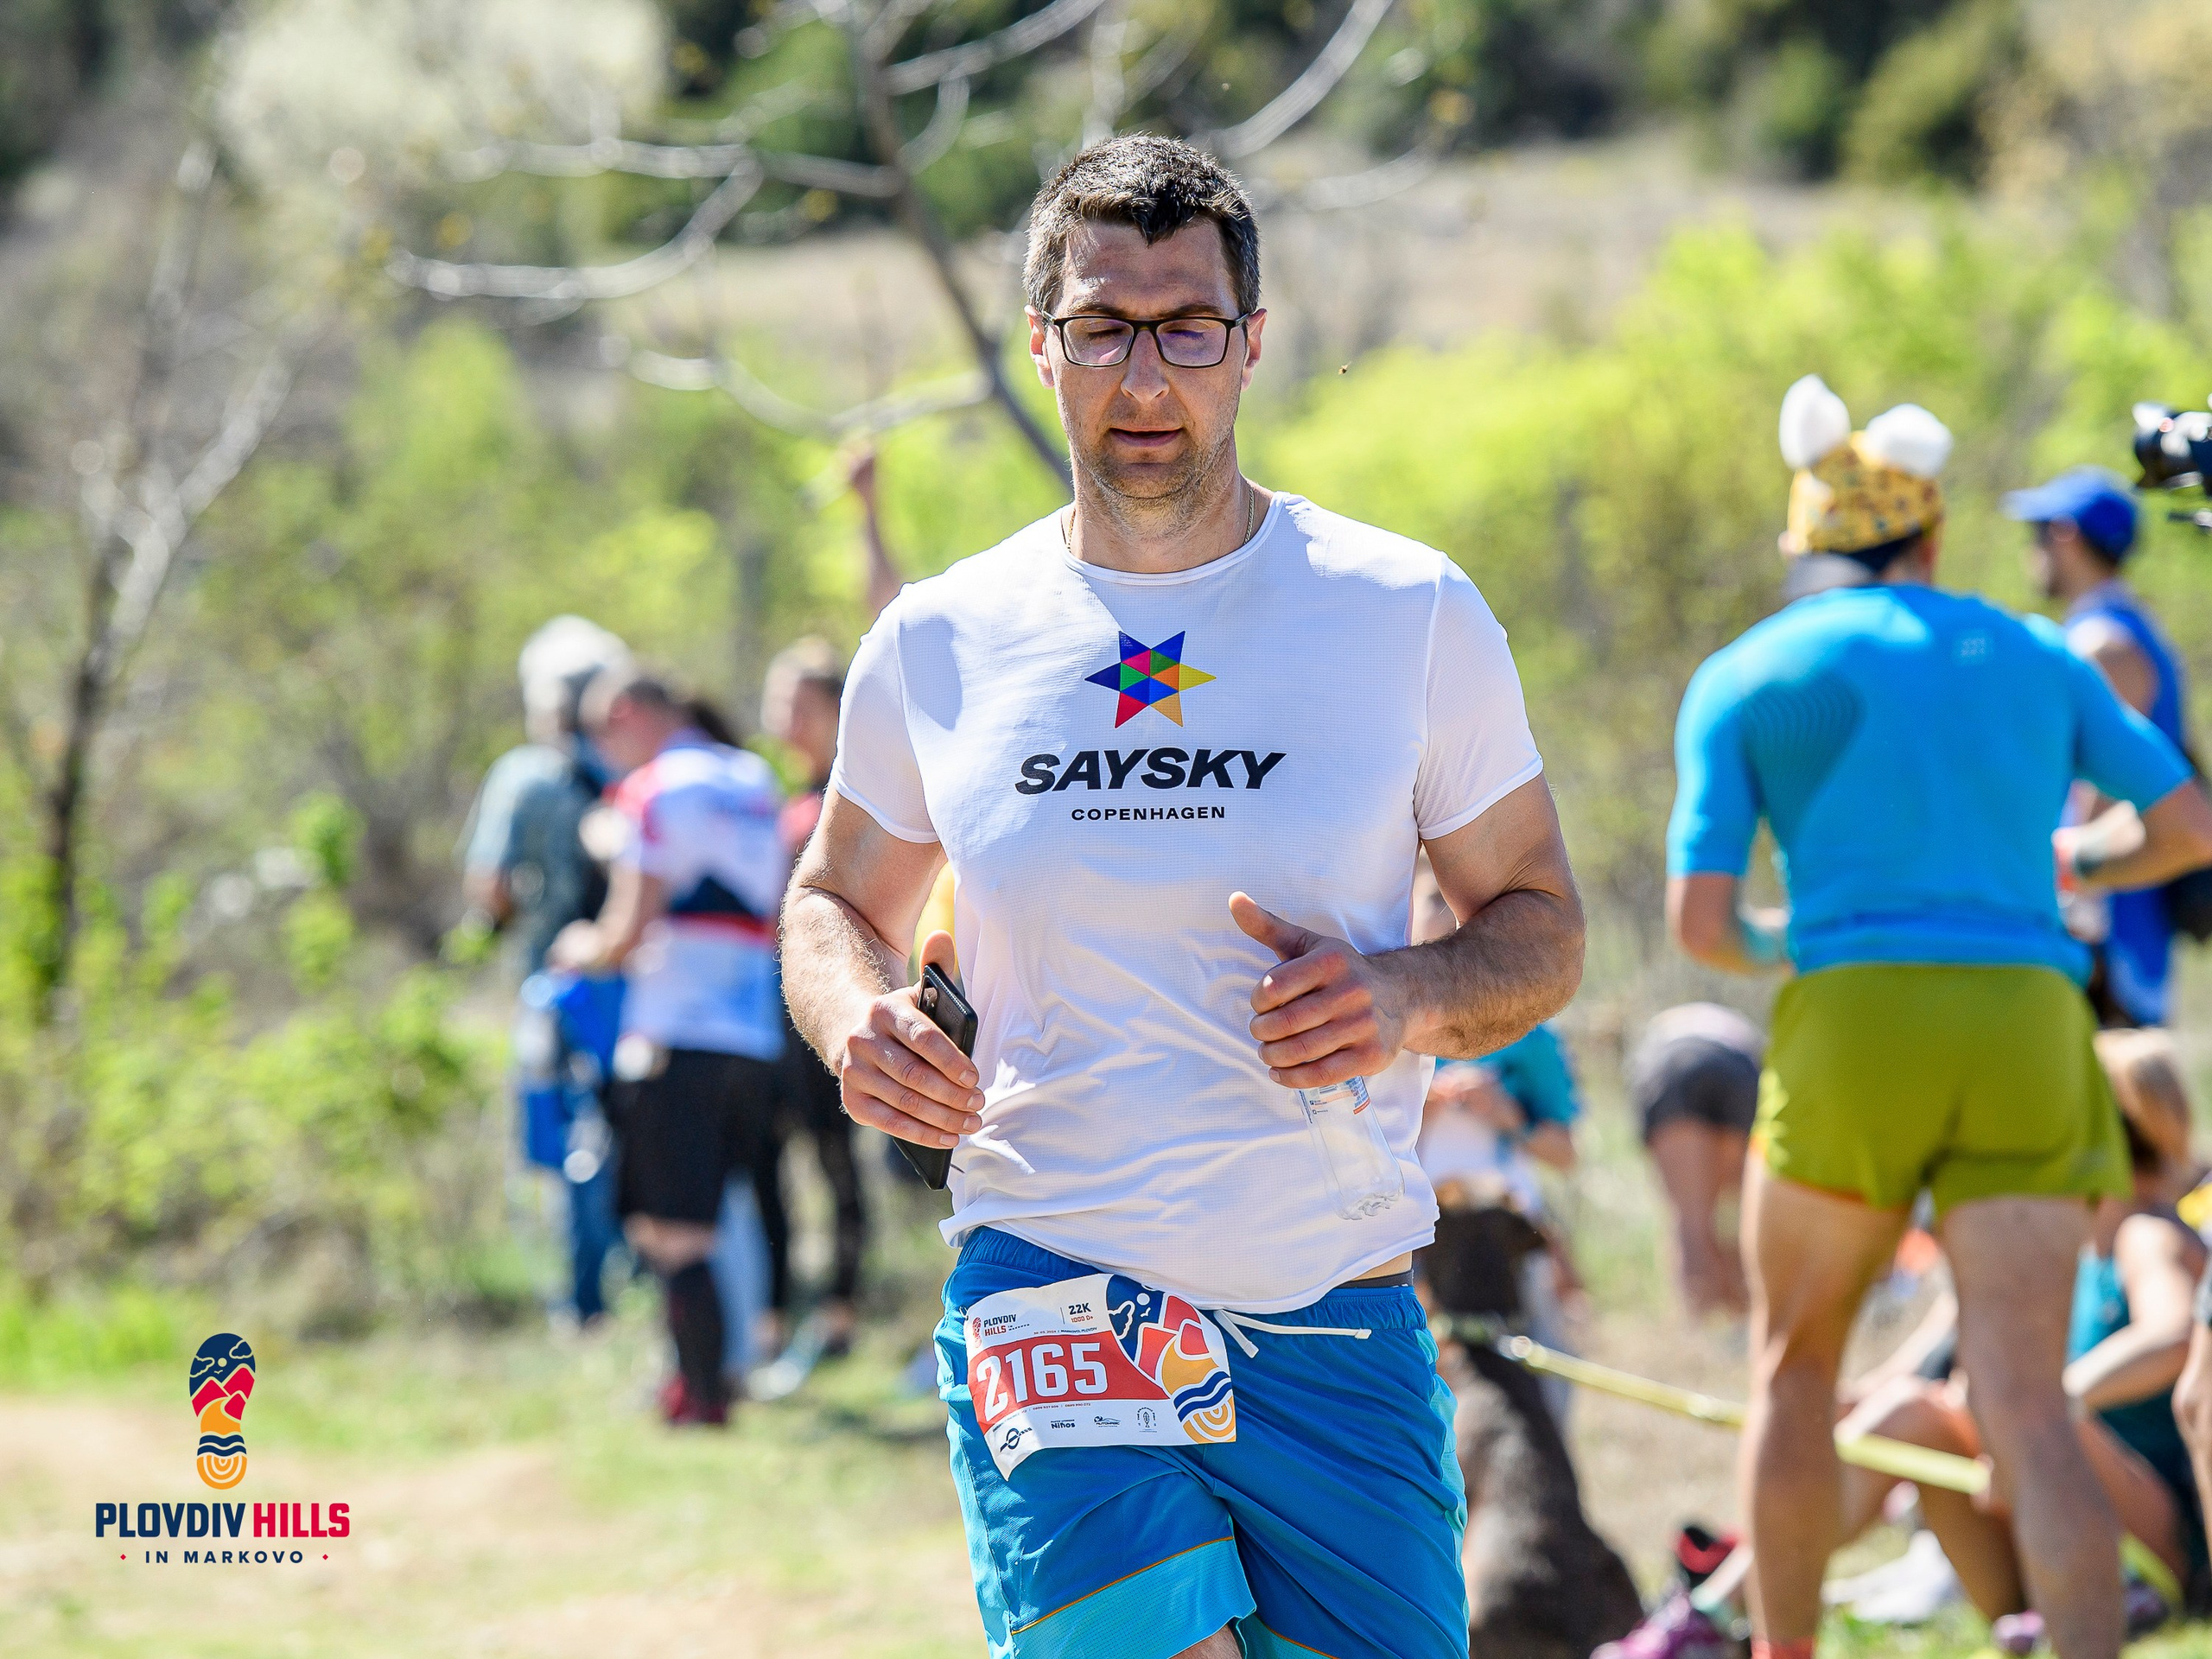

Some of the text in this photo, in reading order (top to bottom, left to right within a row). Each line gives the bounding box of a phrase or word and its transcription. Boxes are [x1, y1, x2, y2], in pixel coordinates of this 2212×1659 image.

[1014, 747, 1287, 794] SAYSKY
[1071, 806, 1225, 821] COPENHAGEN
[1069, 1302, 1091, 1314] 22K
[983, 1314, 1016, 1327] PLOVDIV
[985, 1325, 1007, 1336] HILLS
[976, 1343, 1108, 1421] 2165
